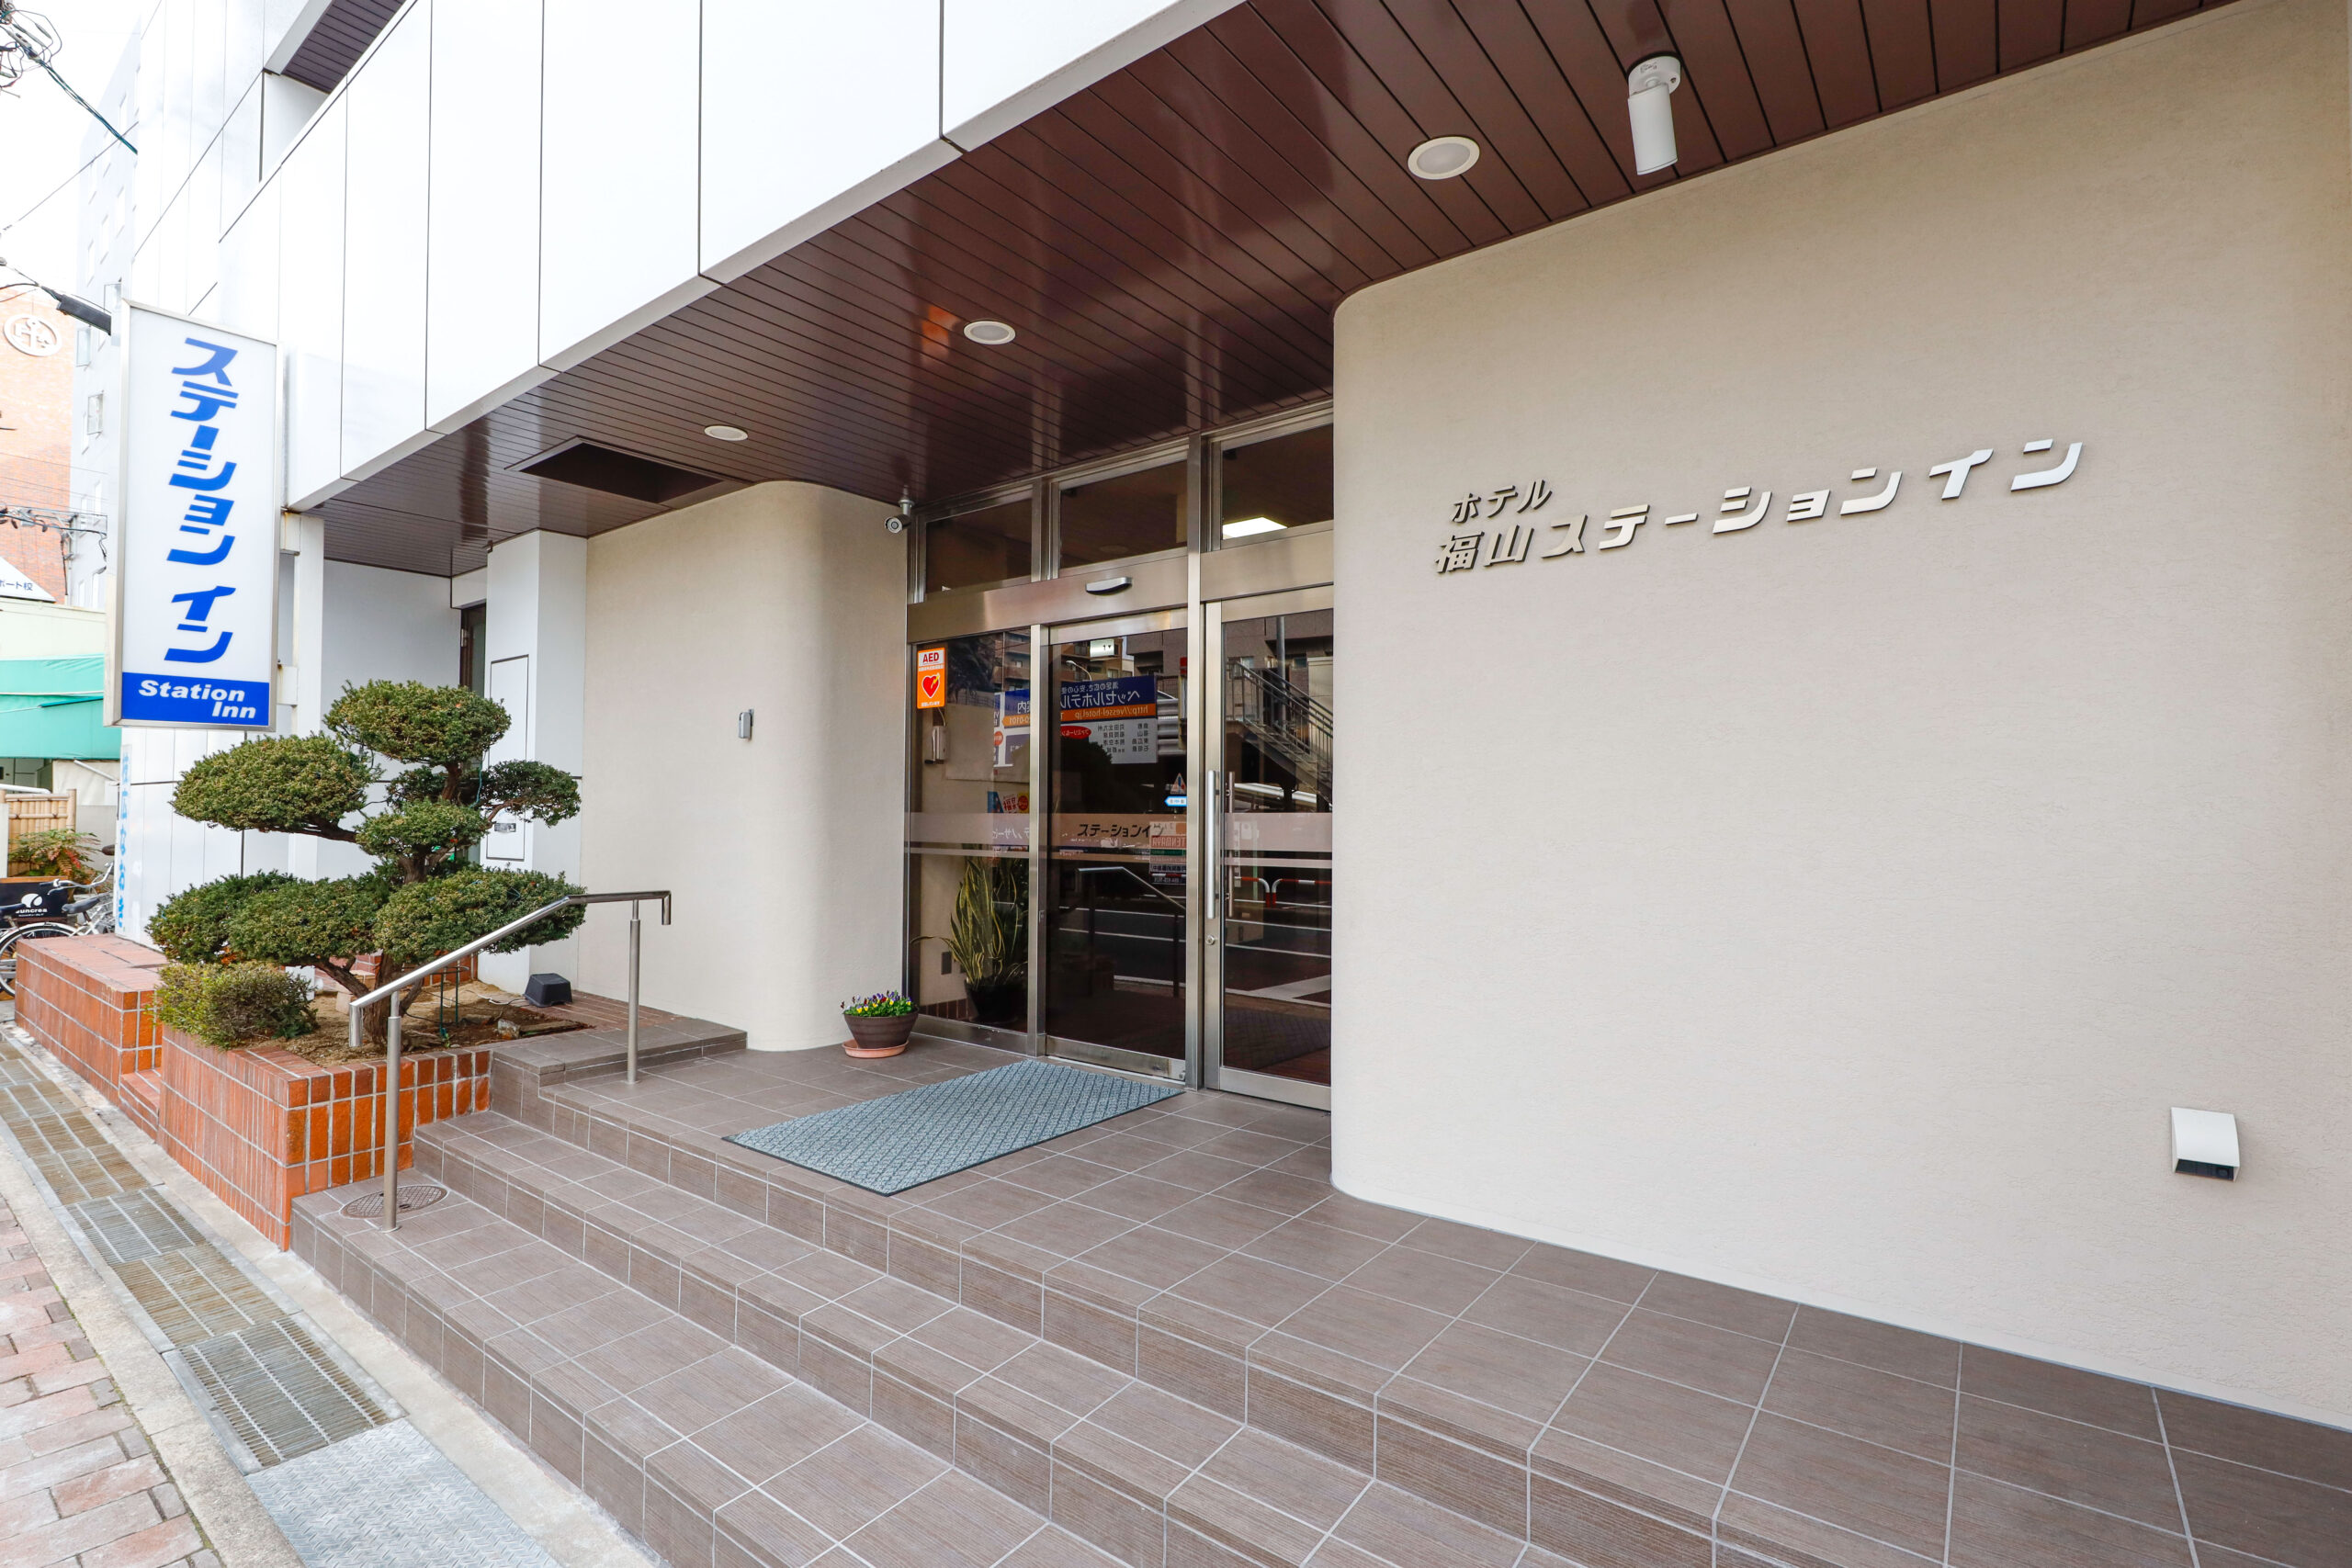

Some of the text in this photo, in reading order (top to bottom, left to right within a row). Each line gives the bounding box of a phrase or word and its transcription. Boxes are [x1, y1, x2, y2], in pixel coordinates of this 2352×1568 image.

[164, 337, 239, 663] ステーションイン
[1435, 438, 2084, 573] 福山ステーションイン
[1452, 479, 1553, 524] ホテル
[922, 651, 940, 663] AED
[138, 680, 245, 702] Station
[211, 701, 256, 718] Inn
[1077, 823, 1164, 838] ステーションイン
